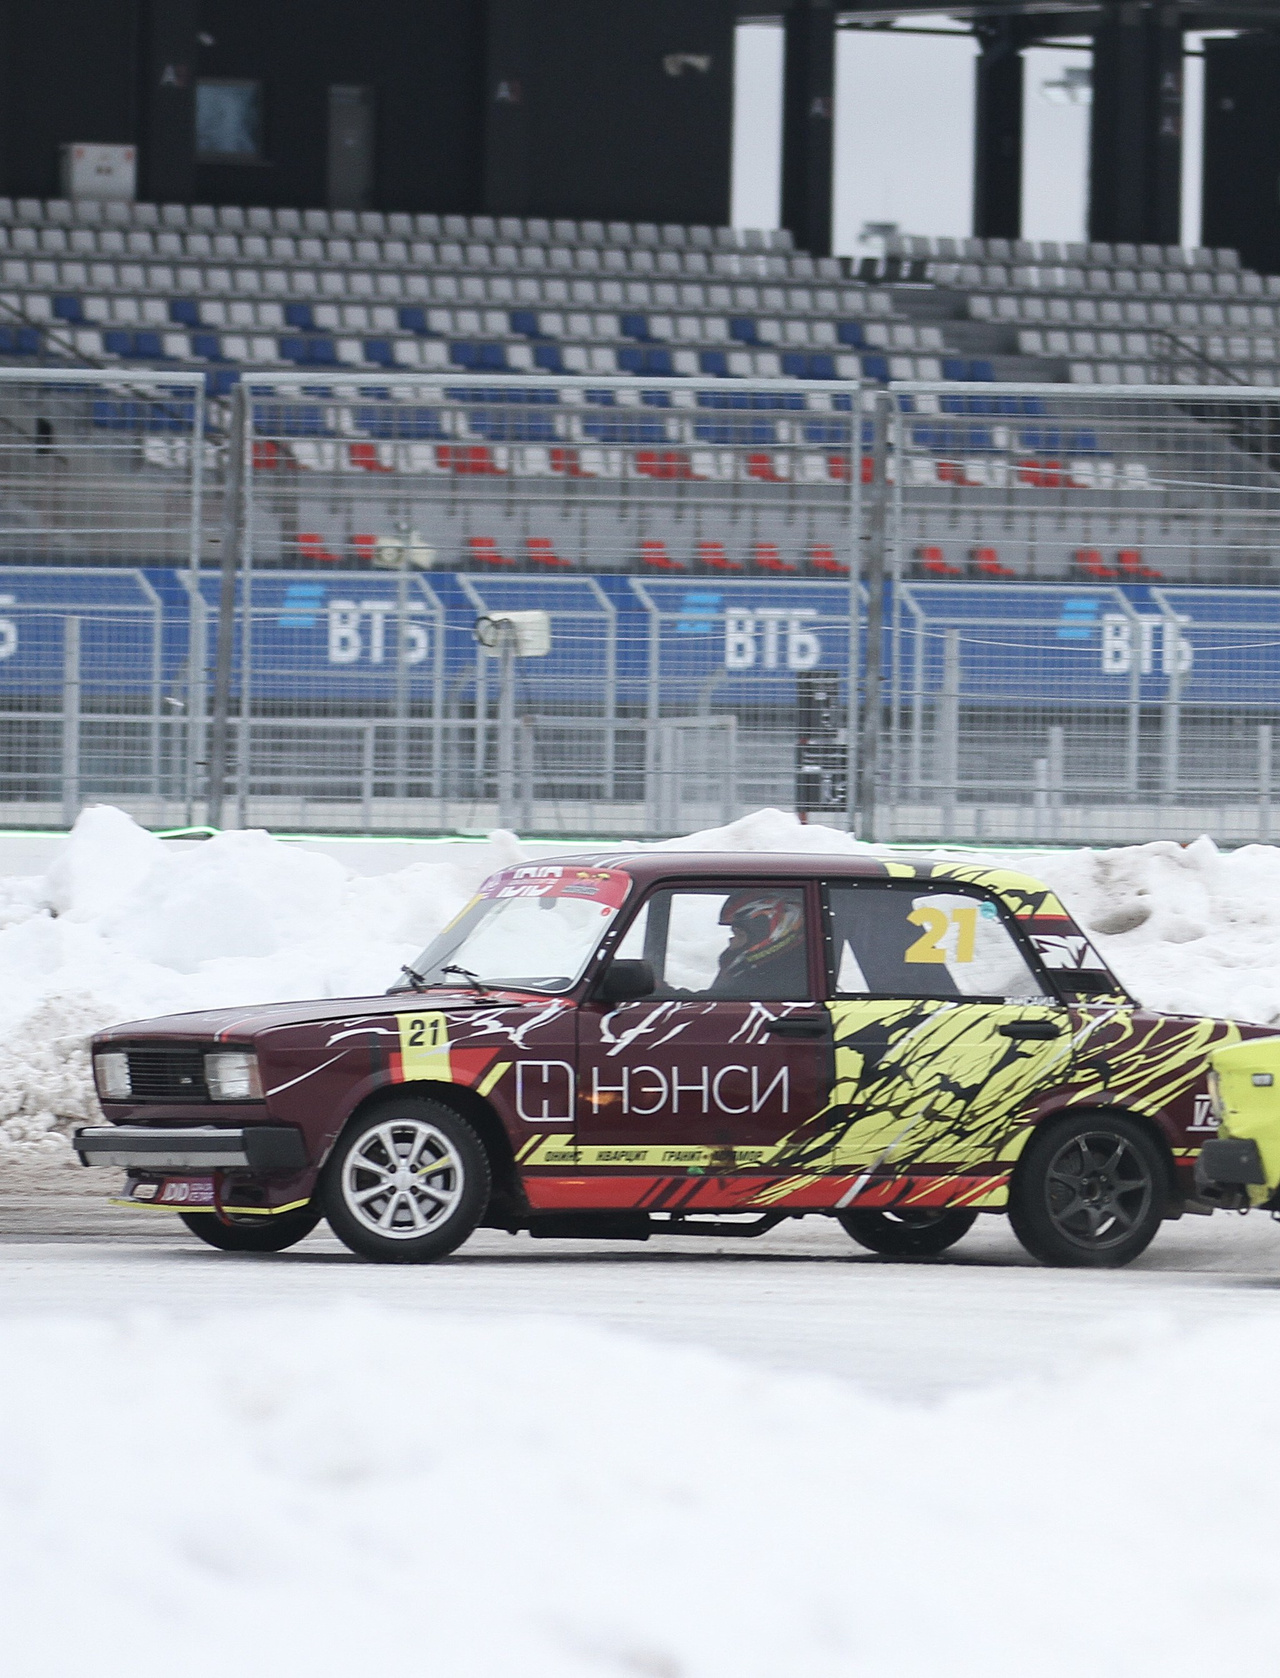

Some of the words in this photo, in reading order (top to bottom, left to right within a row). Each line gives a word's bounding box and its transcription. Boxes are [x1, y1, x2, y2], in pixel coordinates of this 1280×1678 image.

[328, 600, 428, 663] ВТБ
[725, 607, 820, 669] ВТБ
[1102, 614, 1192, 674] ВТБ
[904, 907, 977, 963] 21
[409, 1019, 439, 1047] 21
[592, 1065, 789, 1115] НЭНСИ
[661, 1151, 701, 1162] ГРАНИТ
